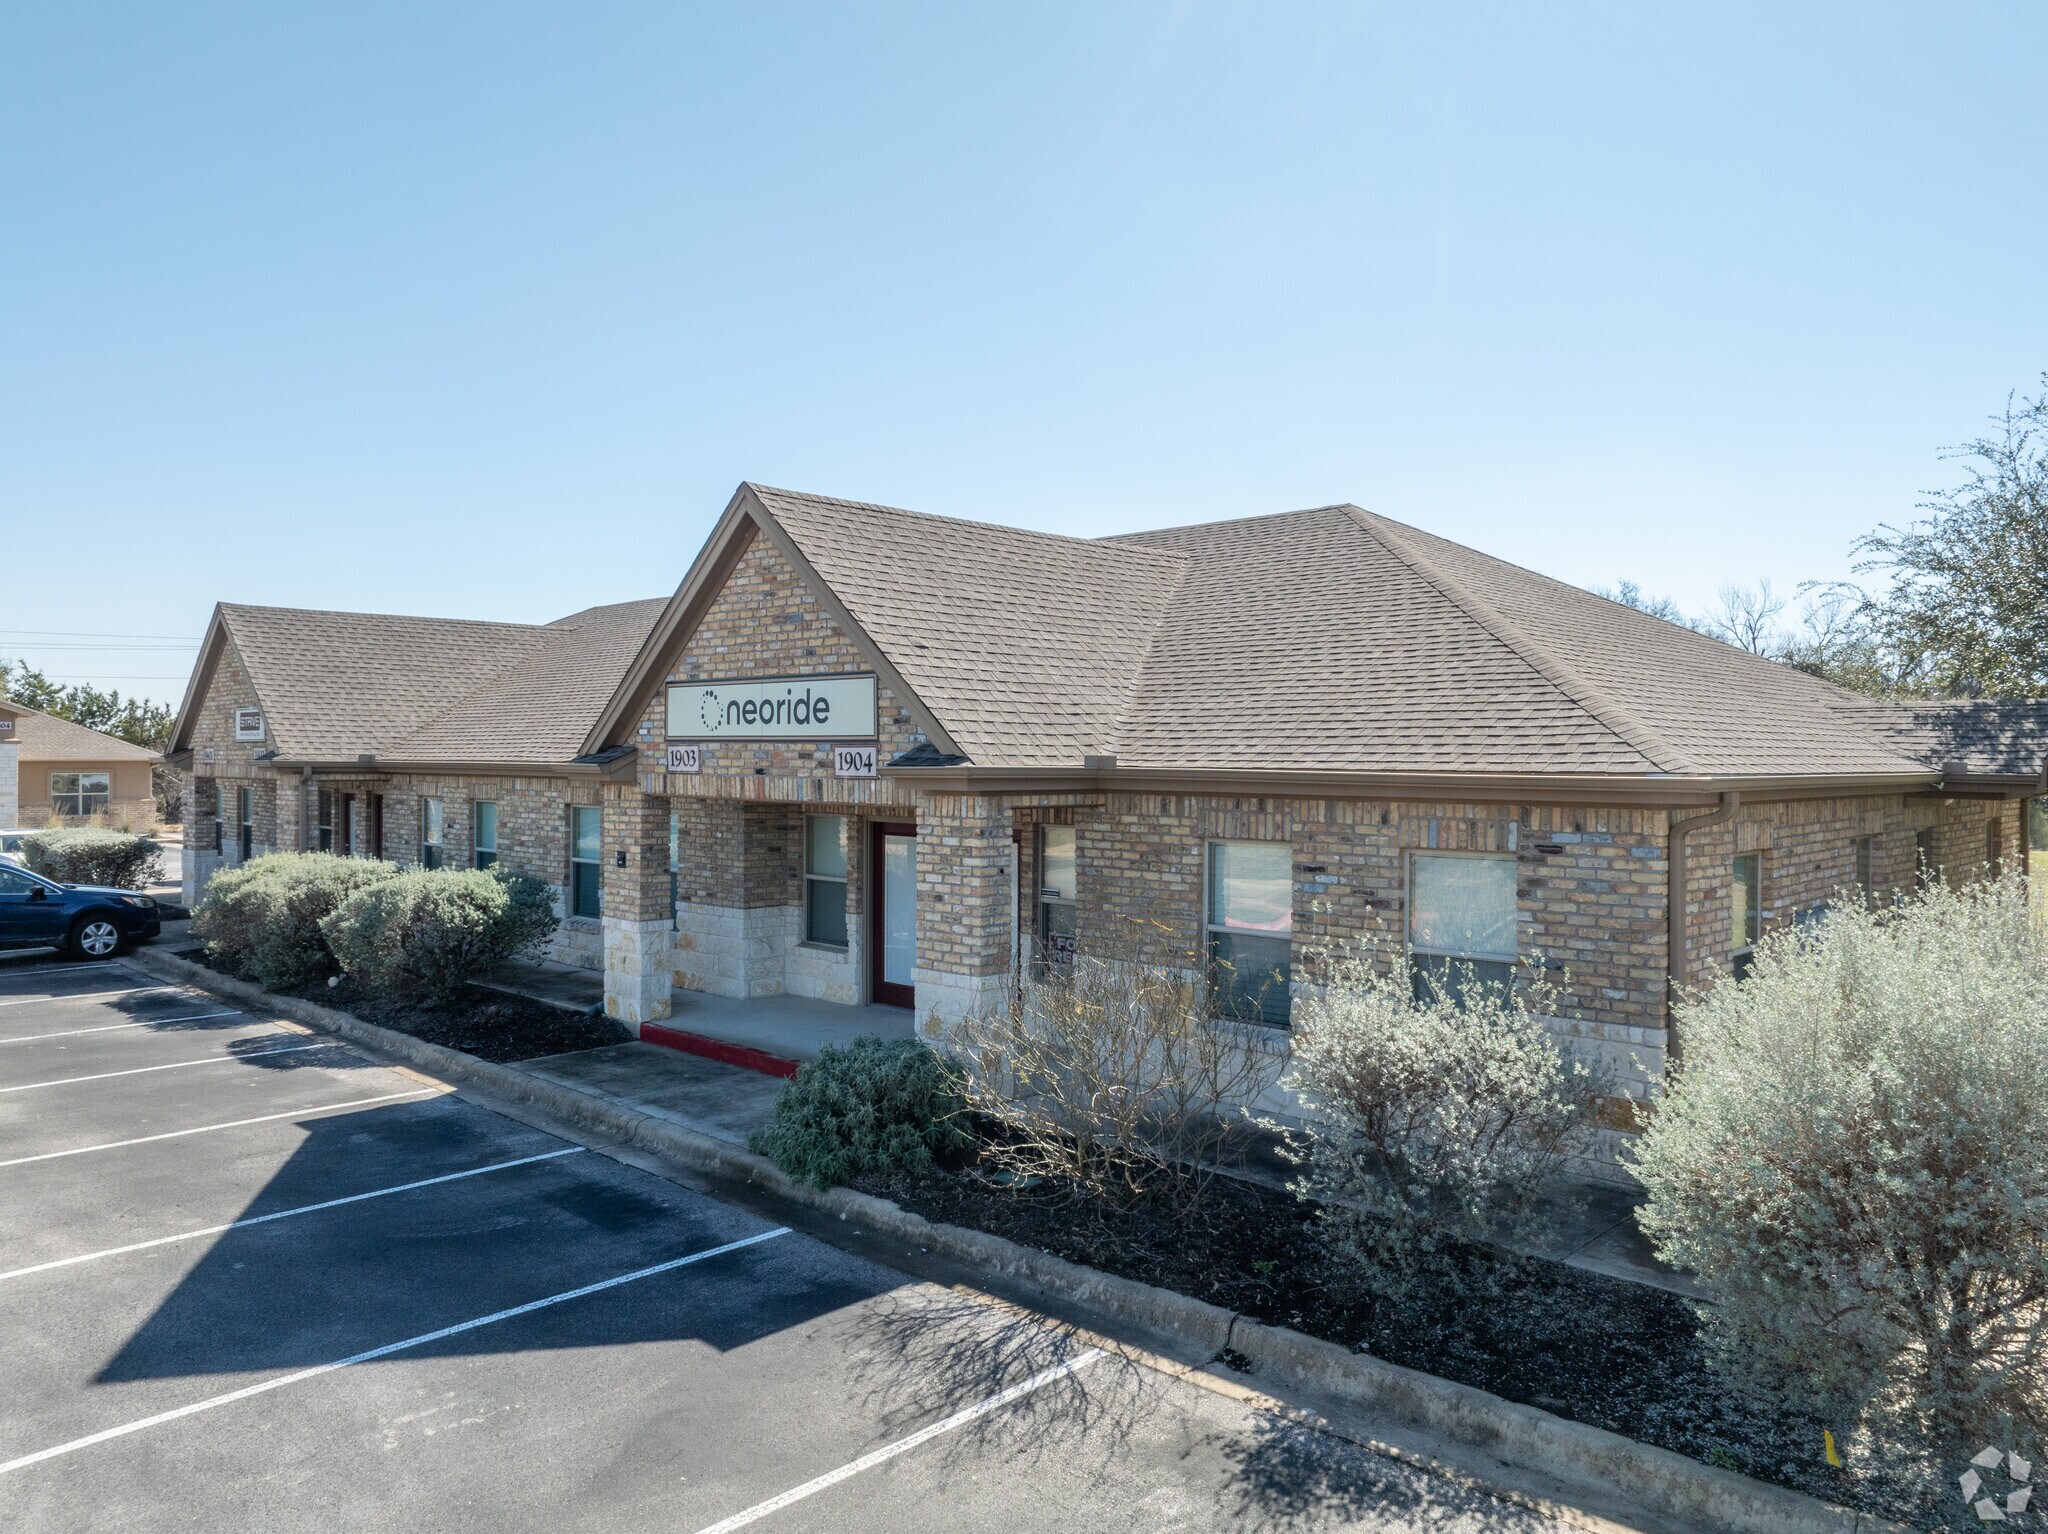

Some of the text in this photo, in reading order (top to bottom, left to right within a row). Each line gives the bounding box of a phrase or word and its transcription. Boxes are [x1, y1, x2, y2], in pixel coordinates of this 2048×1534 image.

[726, 688, 830, 725] neoride
[670, 749, 696, 767] 1903
[837, 751, 873, 773] 1904
